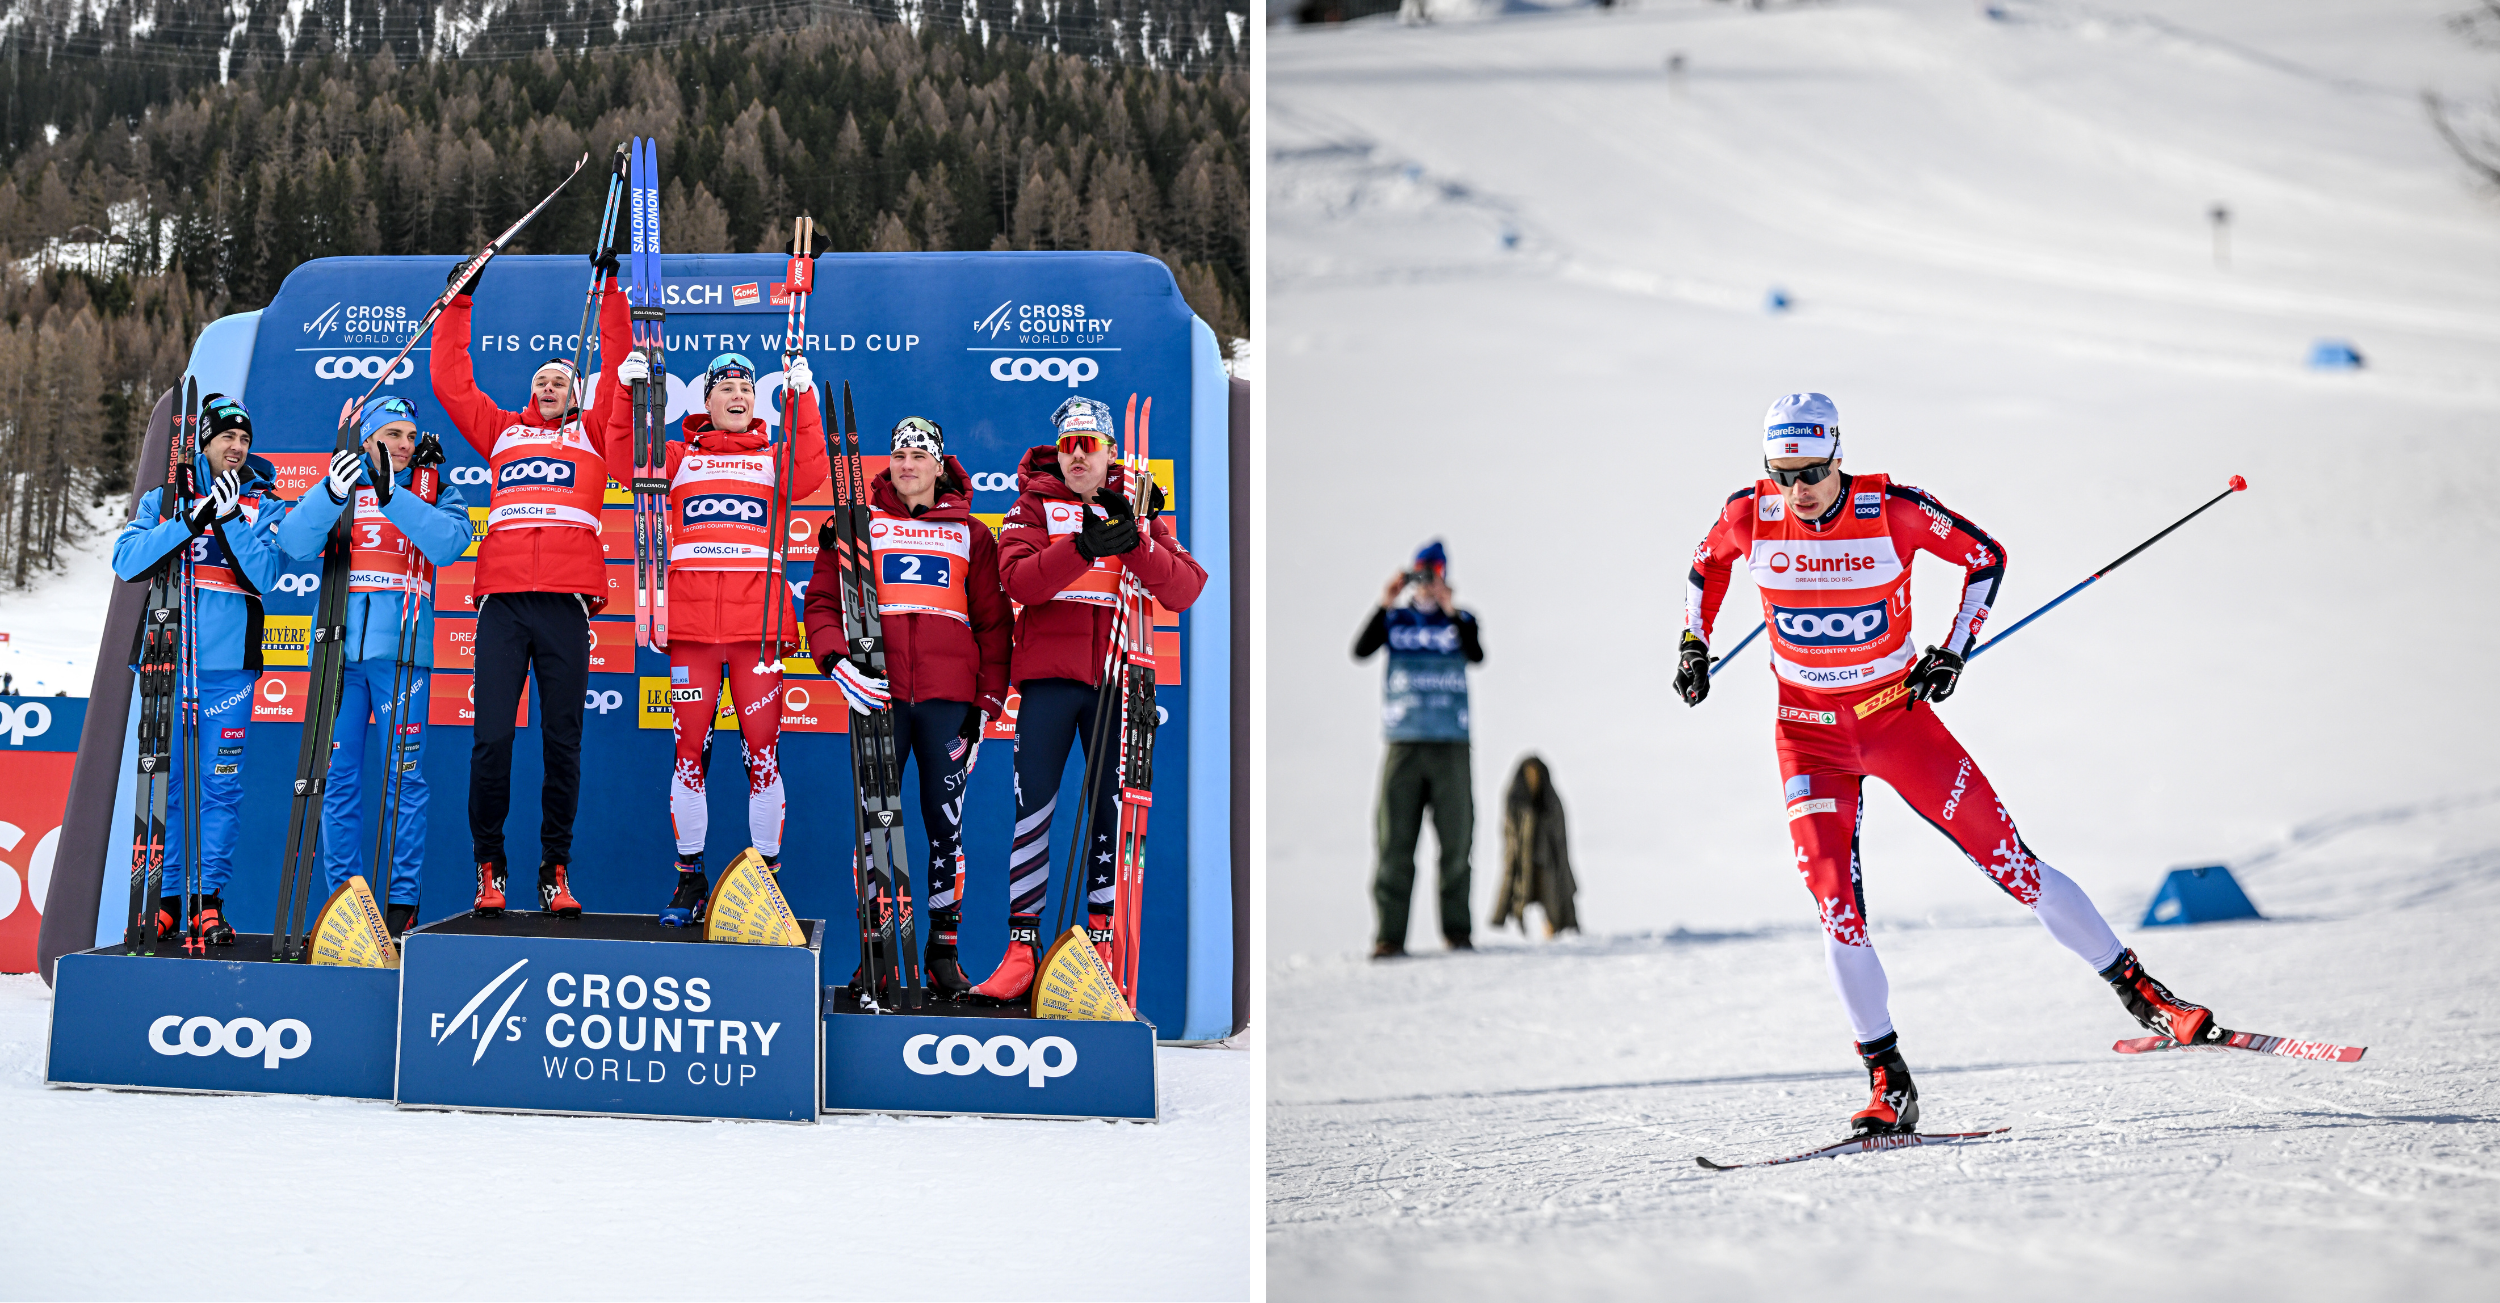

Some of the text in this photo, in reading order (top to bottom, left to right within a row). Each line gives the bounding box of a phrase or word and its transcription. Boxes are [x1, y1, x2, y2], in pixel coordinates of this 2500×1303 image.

[633, 188, 643, 253] SALOMON
[647, 189, 659, 254] SALOMON
[771, 296, 790, 305] Walli
[346, 306, 406, 318] CROSS
[1019, 304, 1085, 318] CROSS
[345, 320, 421, 333] COUNTR
[1019, 319, 1113, 333] COUNTRY
[344, 334, 414, 343] WORLD CU
[482, 335, 520, 351] FIS
[529, 334, 600, 351] CROS
[866, 334, 920, 351] CUP
[1019, 334, 1105, 344] WORLD CUP
[315, 356, 414, 386] coop
[990, 357, 1099, 388] coop
[1768, 426, 1812, 438] SpareBank
[167, 433, 181, 484] ROSSIGNOL
[706, 459, 763, 471] Sunrise
[275, 466, 320, 475] EAM BIG.
[450, 466, 492, 486] coo
[501, 460, 571, 483] coop
[834, 452, 847, 506] ROSSIGNOL
[851, 452, 865, 506] ROSSIGNOL
[287, 480, 308, 489] BIG.
[501, 506, 543, 516] GOMS.CH
[685, 498, 763, 521] coop
[1855, 506, 1880, 515] coop
[735, 524, 756, 532] WORLD
[893, 525, 963, 544] Sunrise
[360, 524, 405, 552] 3 1
[193, 537, 208, 562] 3
[693, 546, 739, 554] GOMS.CH
[899, 555, 948, 585] 2 2
[1795, 553, 1875, 572] Sunrise
[271, 573, 320, 596] op
[349, 574, 390, 584] OMS.CH
[1895, 586, 1906, 609] 1
[262, 625, 306, 643] RUYÈRE
[1776, 609, 1882, 641] coop
[450, 632, 477, 642] DREA
[1786, 641, 1809, 654] CROSS
[1809, 647, 1848, 655] COUNTRY
[1849, 642, 1877, 654] WORLD
[1877, 633, 1891, 647] CUP
[1799, 668, 1858, 682] GOMS.CH
[203, 682, 253, 718] FALCONERI
[647, 690, 662, 704] LE
[744, 688, 780, 716] CRAFT
[254, 704, 293, 716] Sunrise
[1780, 708, 1820, 721] SPAR
[224, 728, 245, 739] enel
[1942, 766, 1970, 821] CRAFT
[901, 920, 914, 939] 197
[546, 971, 711, 1013] CROSS
[148, 1015, 312, 1070] coop
[545, 1013, 781, 1057] COUNTRY
[2258, 1035, 2345, 1062] MADSHUS
[903, 1033, 1078, 1088] coop
[542, 1055, 758, 1088] WORLD CUP
